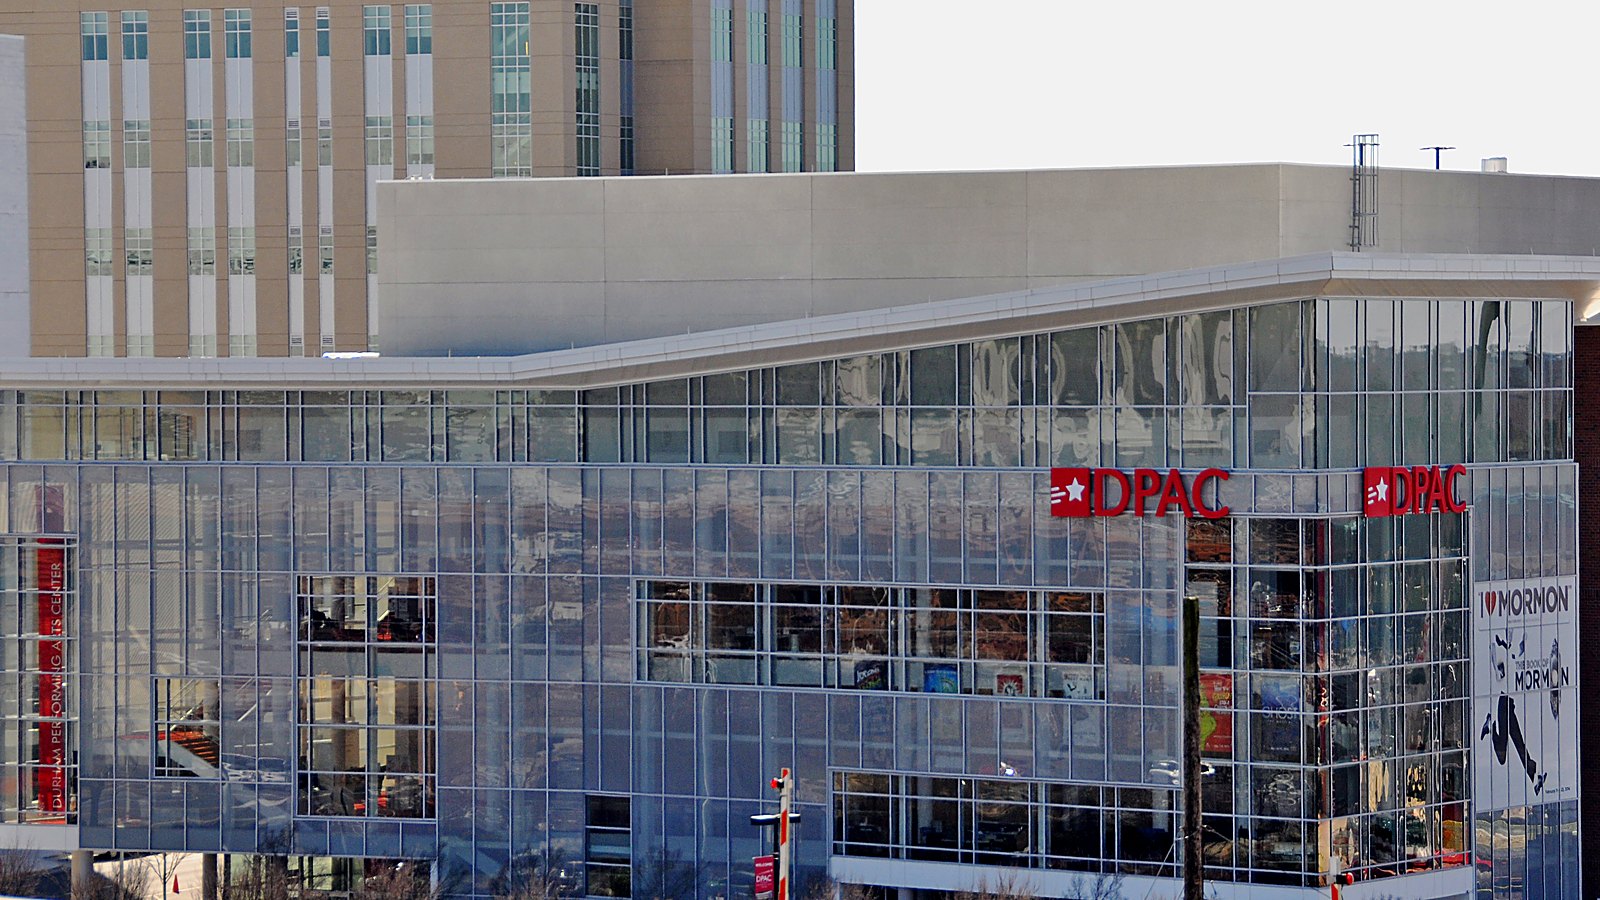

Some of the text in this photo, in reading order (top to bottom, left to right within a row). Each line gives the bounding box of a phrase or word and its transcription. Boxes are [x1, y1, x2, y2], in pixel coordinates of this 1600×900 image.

[1094, 468, 1230, 519] DPAC
[1391, 464, 1468, 516] DPAC
[50, 562, 62, 615] CENTER
[1498, 585, 1569, 617] MORMON
[51, 619, 62, 651] ATS
[1515, 666, 1569, 691] MORMON
[51, 748, 62, 808] DURHAM
[755, 874, 772, 883] DPAC
